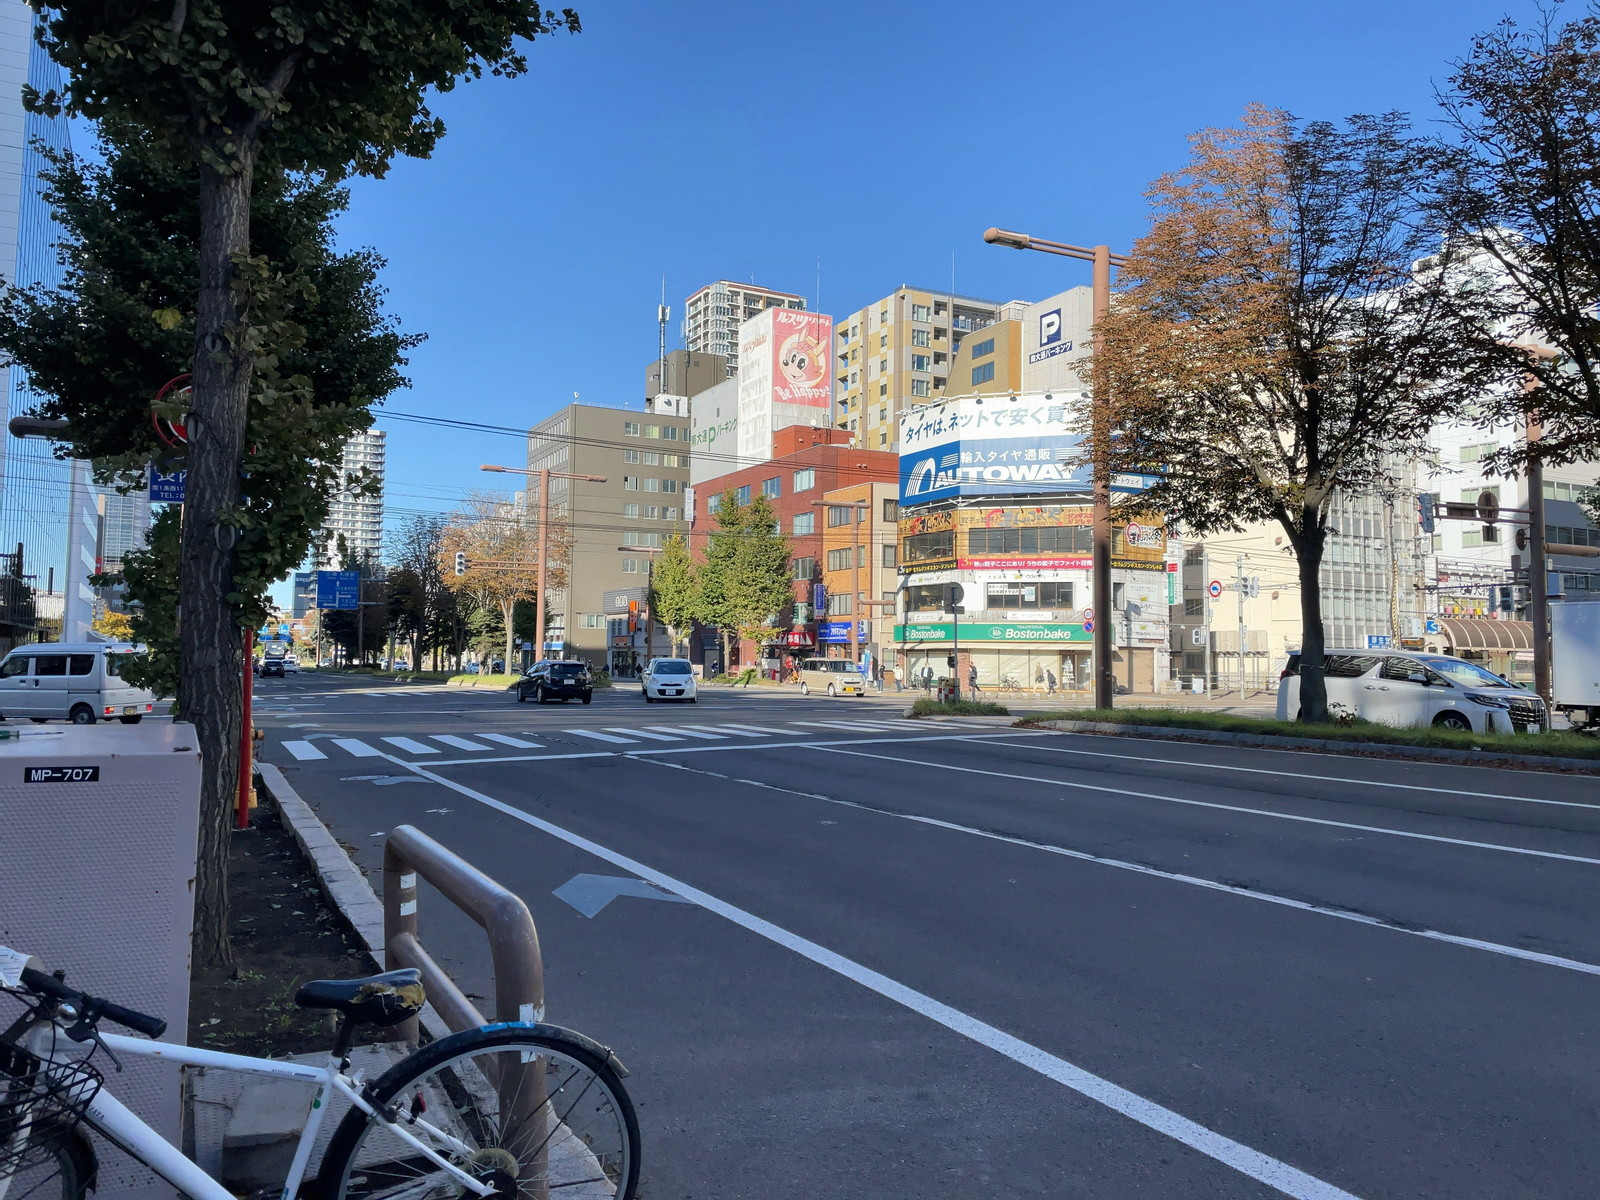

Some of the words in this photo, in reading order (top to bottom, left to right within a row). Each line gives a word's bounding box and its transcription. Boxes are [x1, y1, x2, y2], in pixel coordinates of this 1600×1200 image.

[1042, 313, 1060, 344] P
[774, 386, 792, 400] Be
[961, 448, 1051, 464] 輸入タイヤ通販
[934, 463, 1075, 487] AUTOWAY
[910, 629, 945, 639] Bostonbake
[1005, 629, 1071, 639] Bostonbake
[31, 769, 93, 781] MP-707
